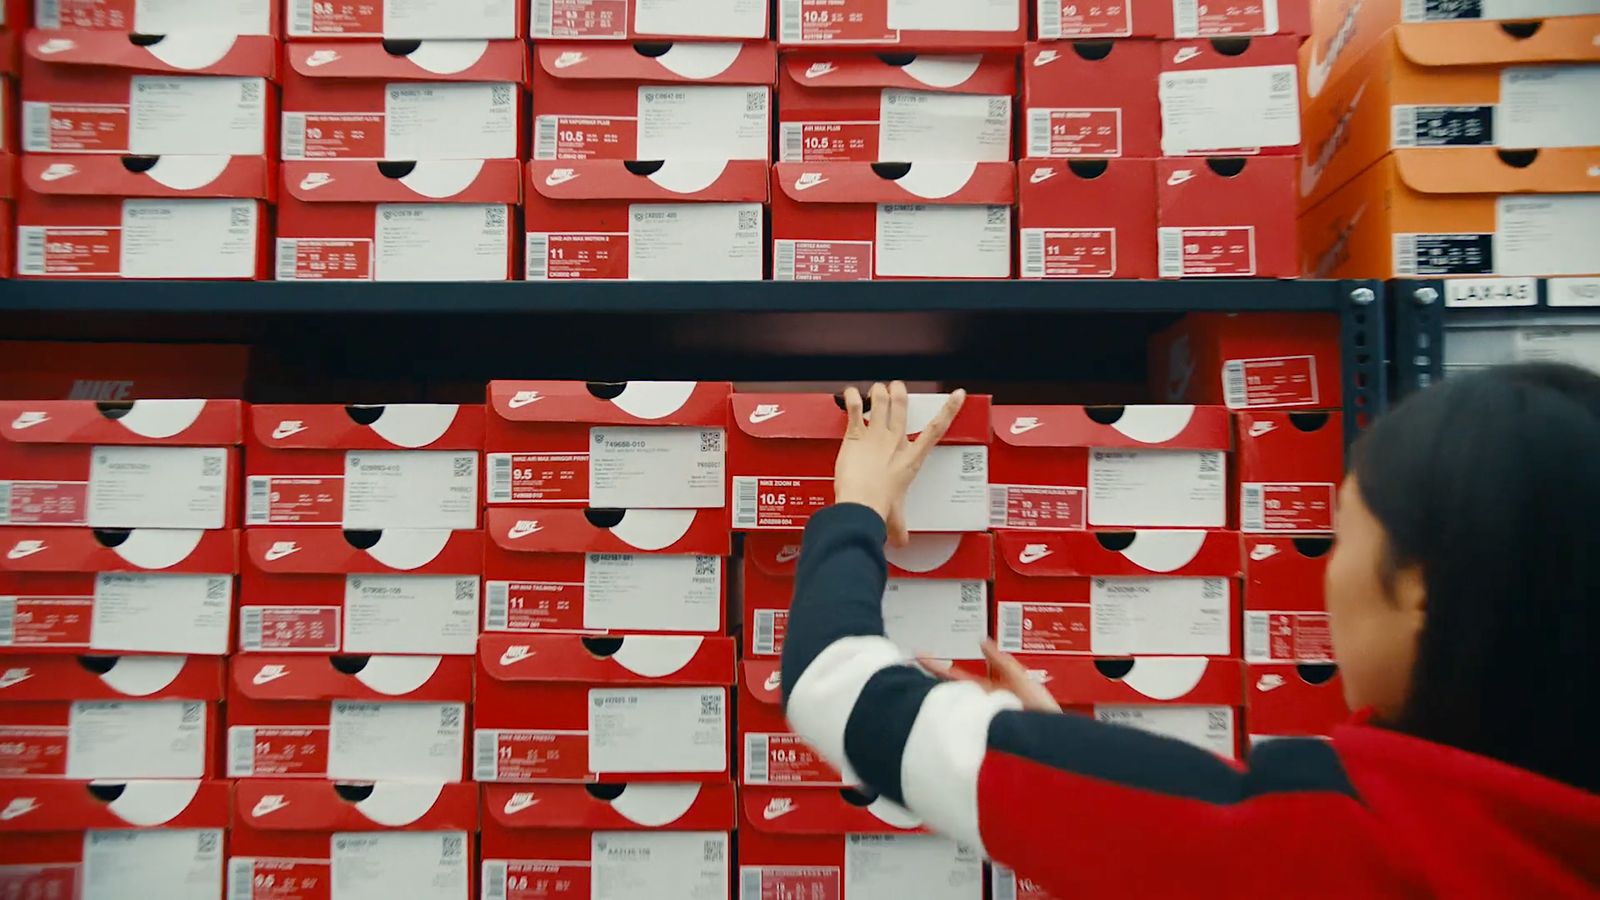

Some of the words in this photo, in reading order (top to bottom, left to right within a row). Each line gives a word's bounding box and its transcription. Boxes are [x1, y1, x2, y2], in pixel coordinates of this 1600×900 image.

[804, 11, 829, 22] 10.5
[1053, 125, 1066, 135] 11
[559, 131, 583, 142] 10.5
[804, 138, 829, 149] 10.5
[550, 248, 564, 259] 11
[1047, 245, 1060, 255] 11
[810, 255, 825, 263] 10.5
[810, 264, 819, 272] 12
[69, 379, 133, 400] NIKE
[604, 440, 646, 448] 749688-010
[513, 469, 532, 480] 9.5
[760, 493, 786, 505] 10.5
[510, 597, 524, 608] 11
[1023, 618, 1033, 630] 9
[500, 746, 512, 759] 11
